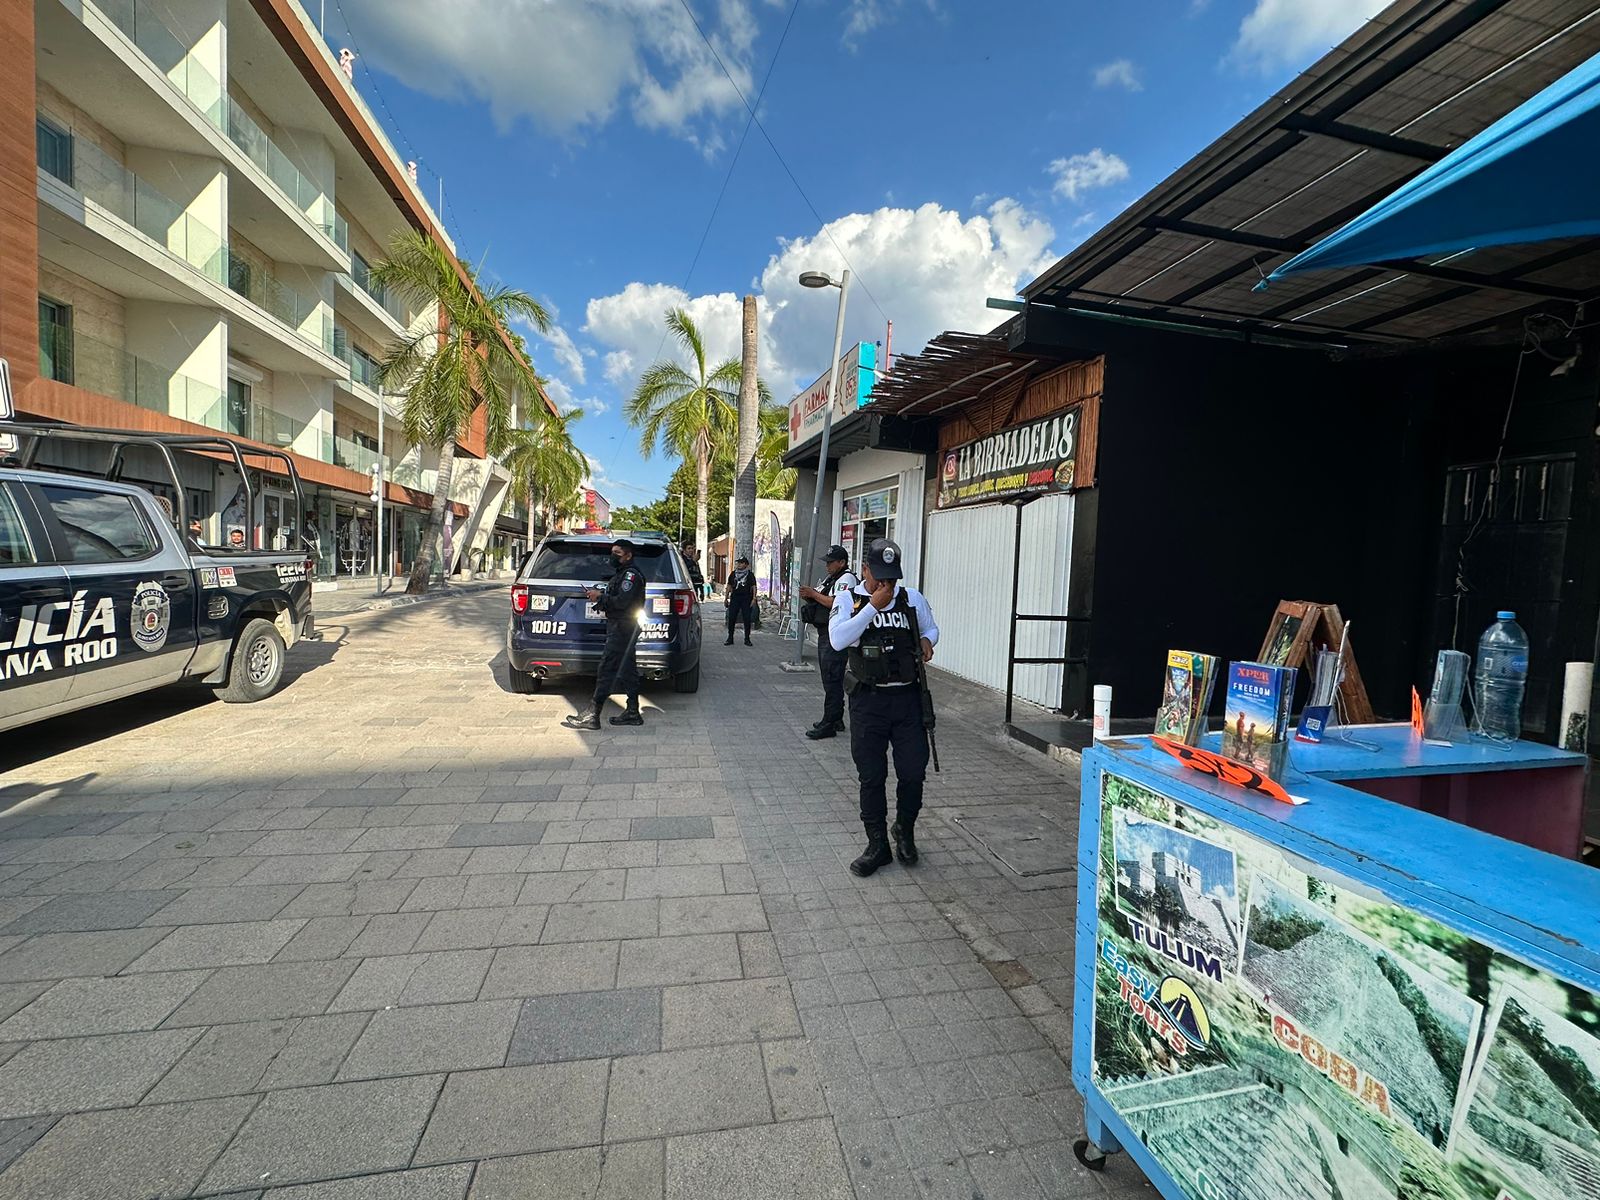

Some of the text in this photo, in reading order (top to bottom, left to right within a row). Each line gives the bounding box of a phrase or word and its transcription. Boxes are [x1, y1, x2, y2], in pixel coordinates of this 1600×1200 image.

[804, 380, 838, 414] FARMAC
[959, 446, 971, 482] LA
[531, 620, 567, 635] 10012
[638, 631, 669, 639] ANINA
[866, 612, 910, 630] OLICIA
[0, 637, 117, 679] NA ROO
[1233, 682, 1271, 696] FREEDOM
[1129, 918, 1223, 983] TULUM
[1102, 939, 1158, 1002] Easy
[1118, 975, 1187, 1055] Tours
[1273, 1015, 1391, 1118] COBA
